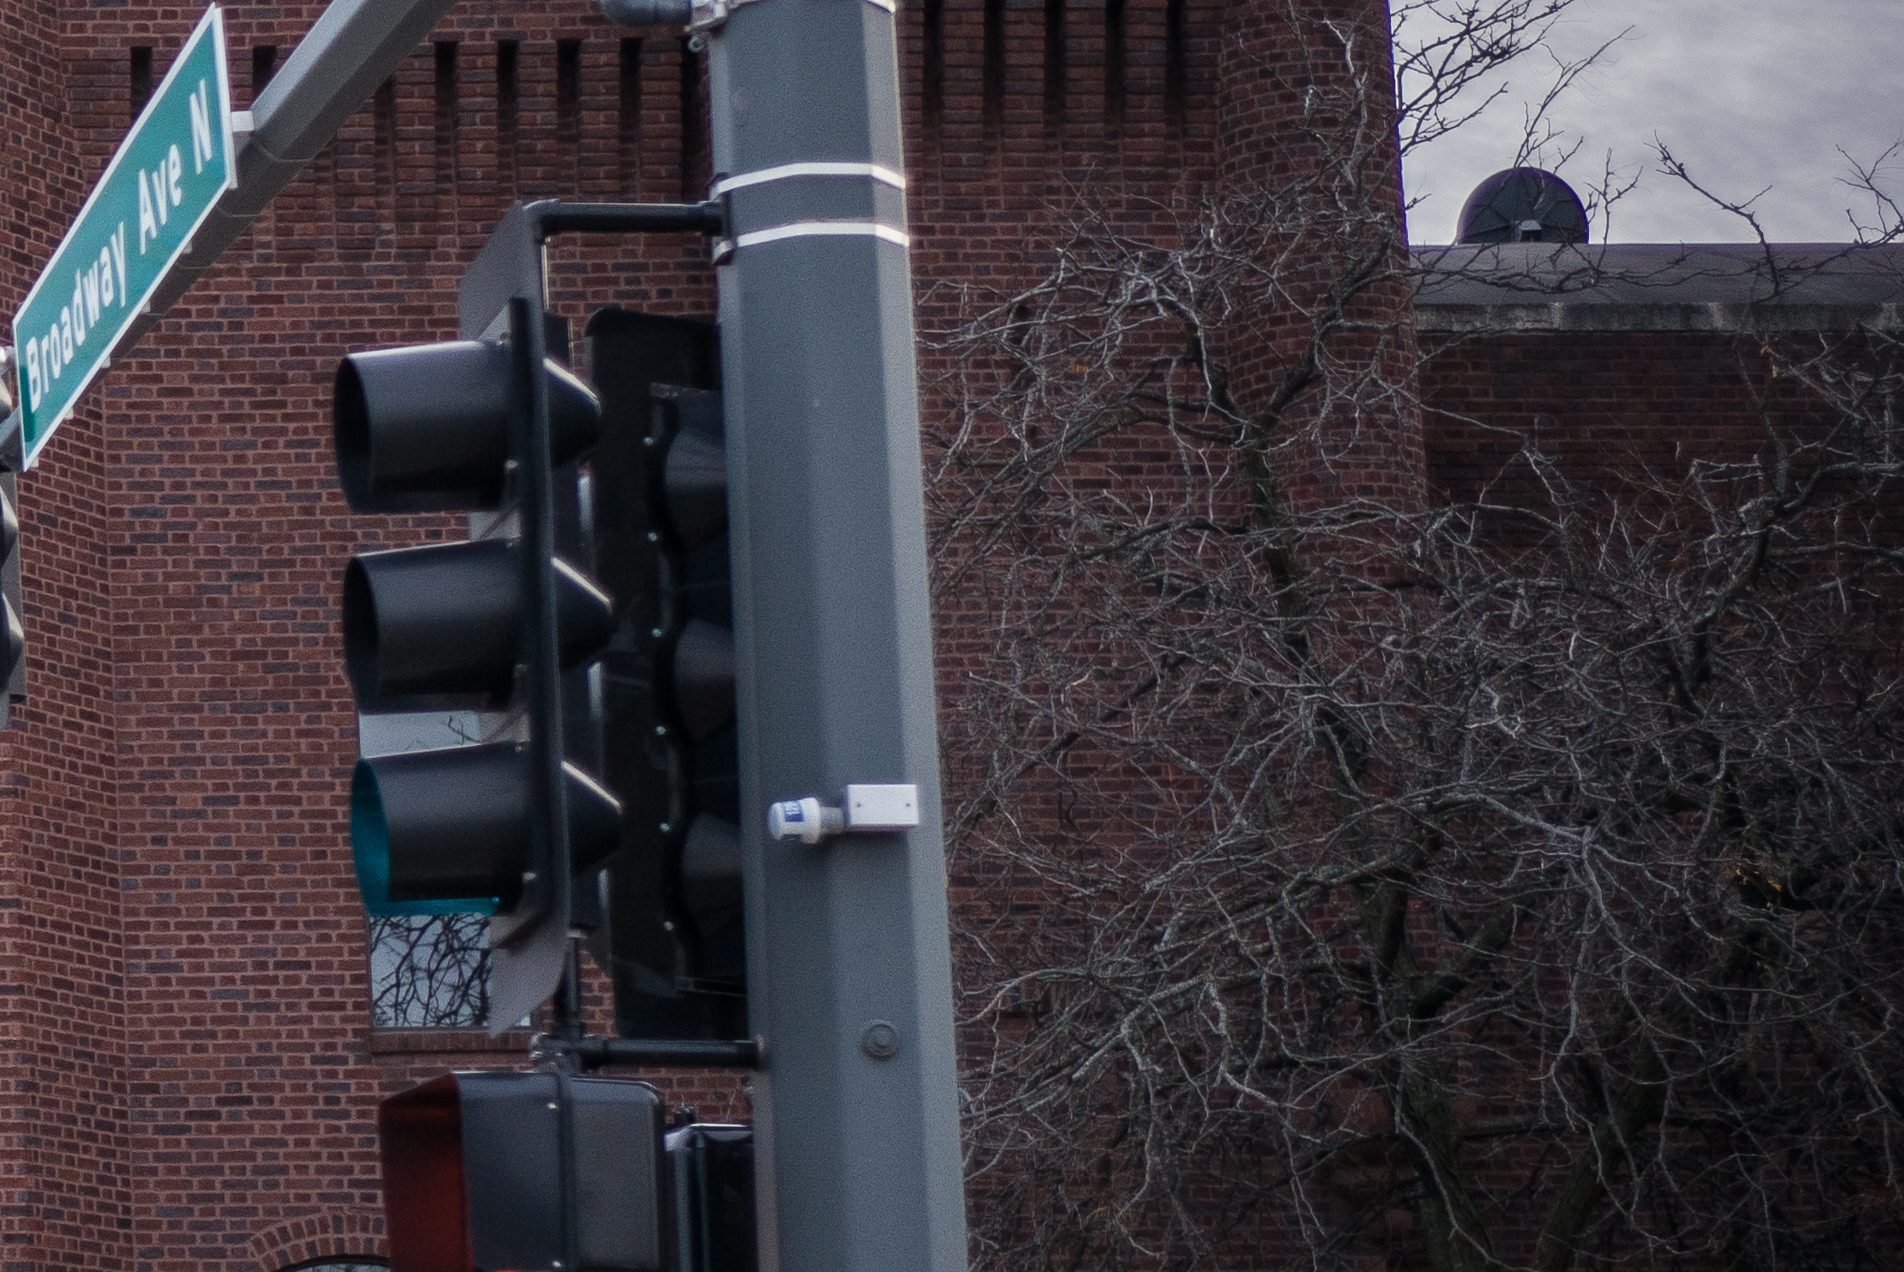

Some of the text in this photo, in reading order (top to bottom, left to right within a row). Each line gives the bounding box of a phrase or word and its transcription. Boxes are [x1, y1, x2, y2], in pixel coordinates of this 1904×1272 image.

[25, 79, 213, 413] Broadway Ave N
